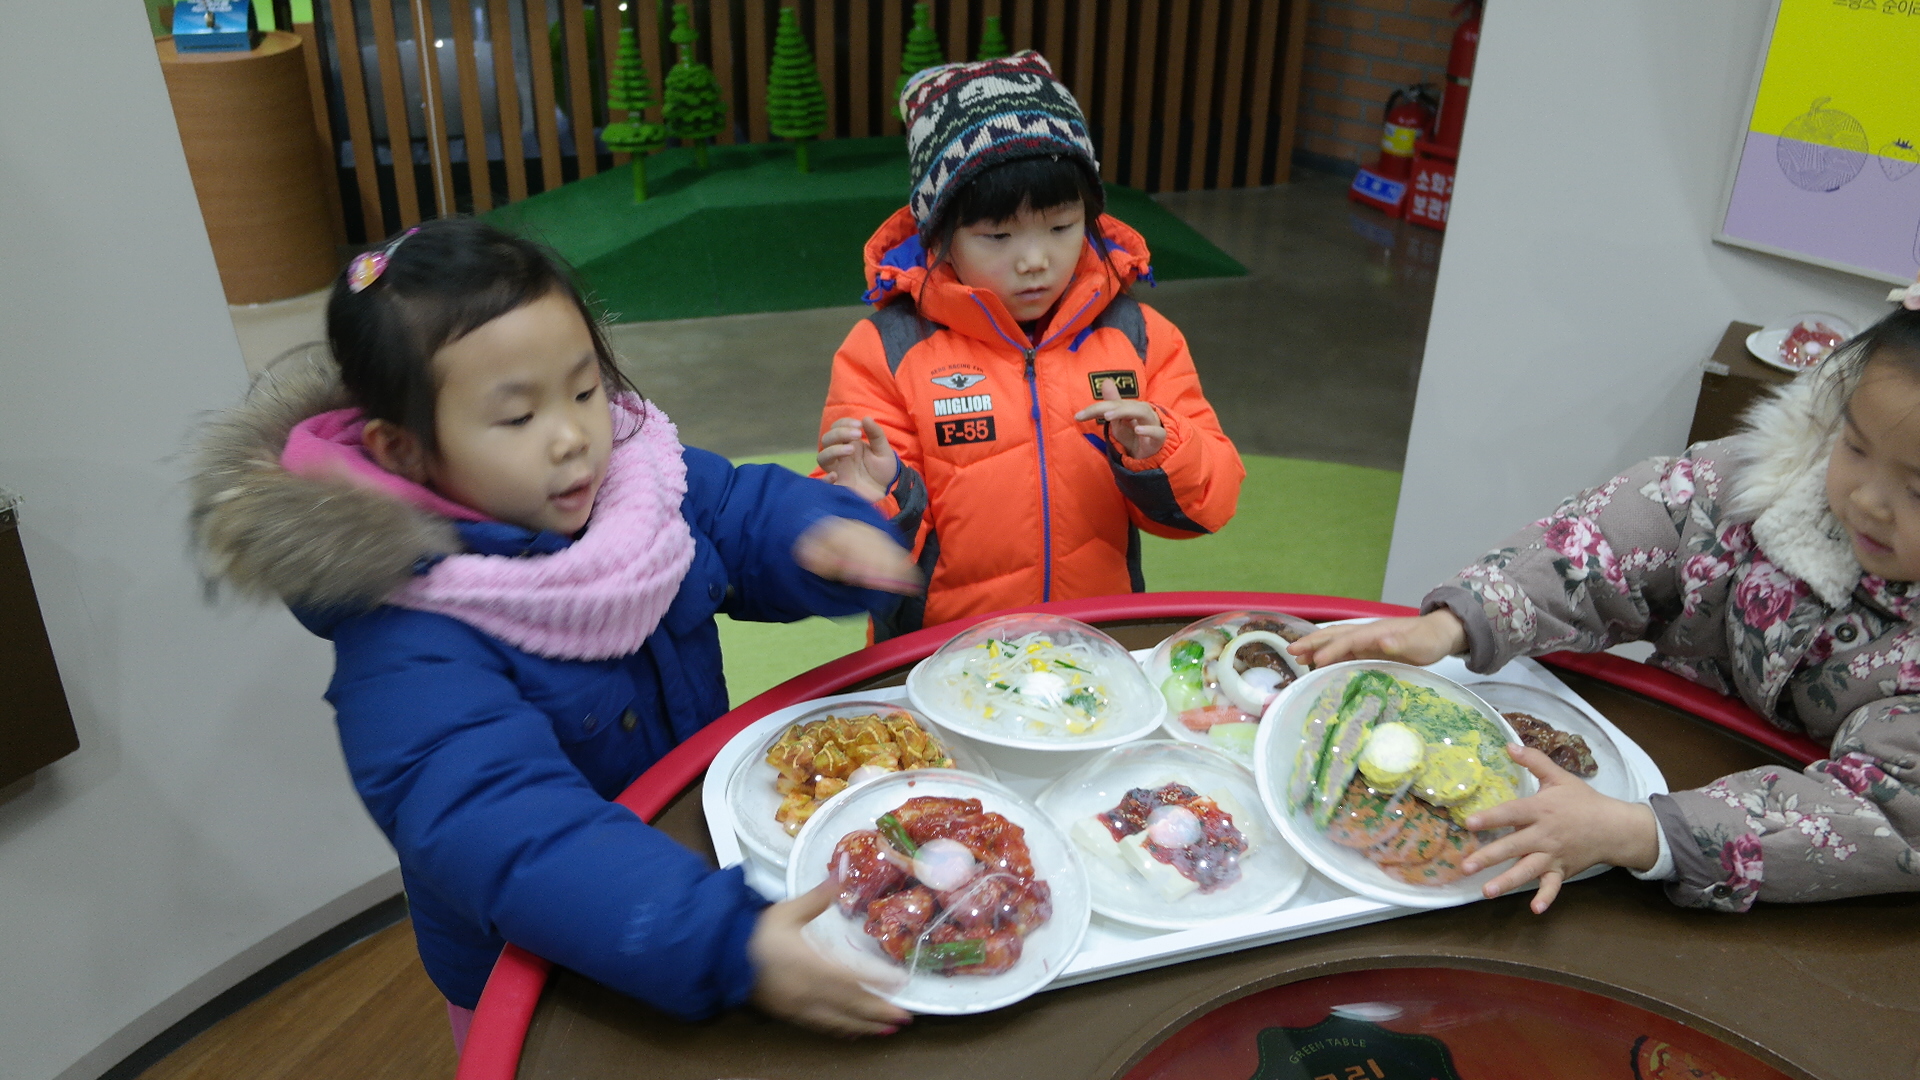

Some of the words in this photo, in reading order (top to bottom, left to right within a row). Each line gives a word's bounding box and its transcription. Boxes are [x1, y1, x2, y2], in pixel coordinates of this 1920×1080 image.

[933, 394, 993, 417] MIGLIOR
[942, 419, 989, 443] F-55
[1289, 1040, 1325, 1064] GREEN
[1325, 1037, 1367, 1049] TABLE
